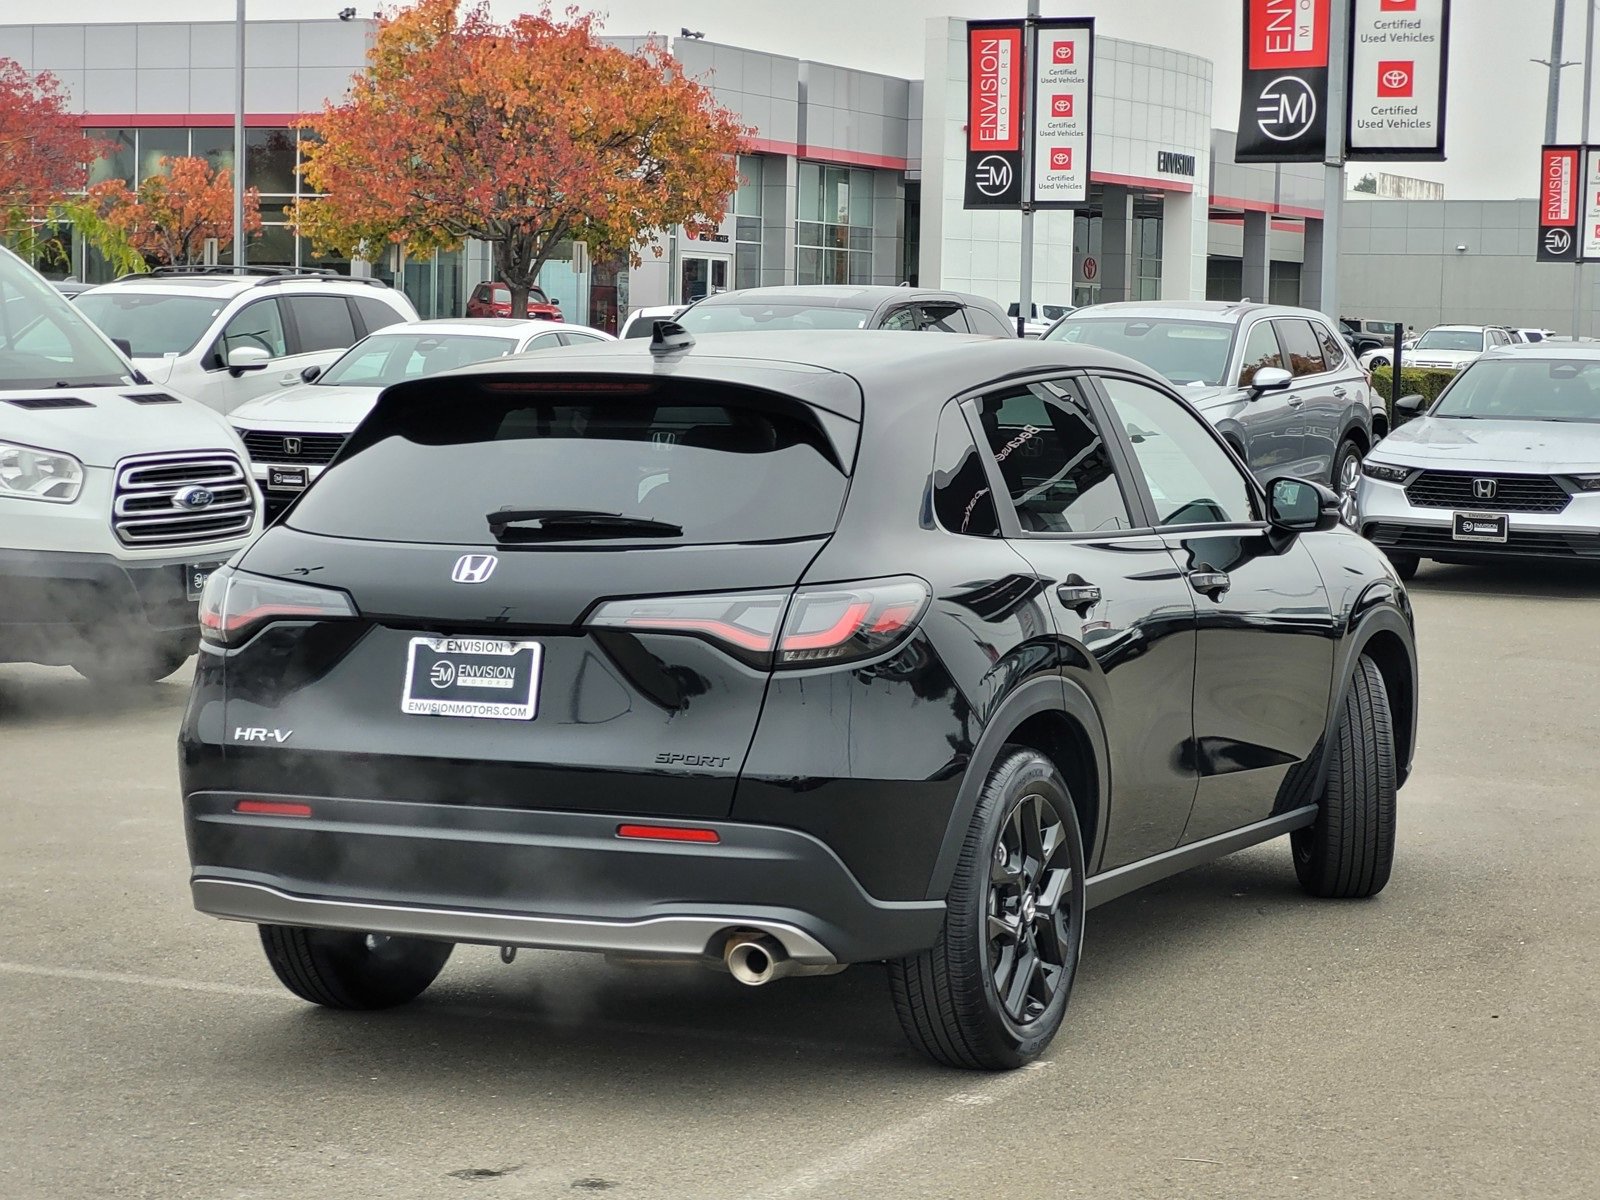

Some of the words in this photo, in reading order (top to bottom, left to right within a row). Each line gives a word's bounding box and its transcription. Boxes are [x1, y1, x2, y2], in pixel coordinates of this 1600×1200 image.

[1374, 19, 1421, 30] Certified
[1360, 33, 1387, 43] Used
[1389, 32, 1435, 43] Vehicles
[1049, 68, 1077, 76] Certified
[980, 39, 998, 141] ENVISION
[999, 48, 1008, 132] MOTORS
[1371, 105, 1418, 116] Certified
[1357, 119, 1384, 129] Used
[1386, 119, 1432, 129] Vehicles
[1157, 150, 1196, 177] ENVISION
[1547, 156, 1562, 220] ENVISION
[446, 640, 504, 653] ENVISION
[457, 664, 516, 679] ENVISION
[407, 701, 527, 717] ENVISIONMOTORS.COM
[233, 726, 294, 743] HR-V
[654, 752, 731, 768] SPORT
